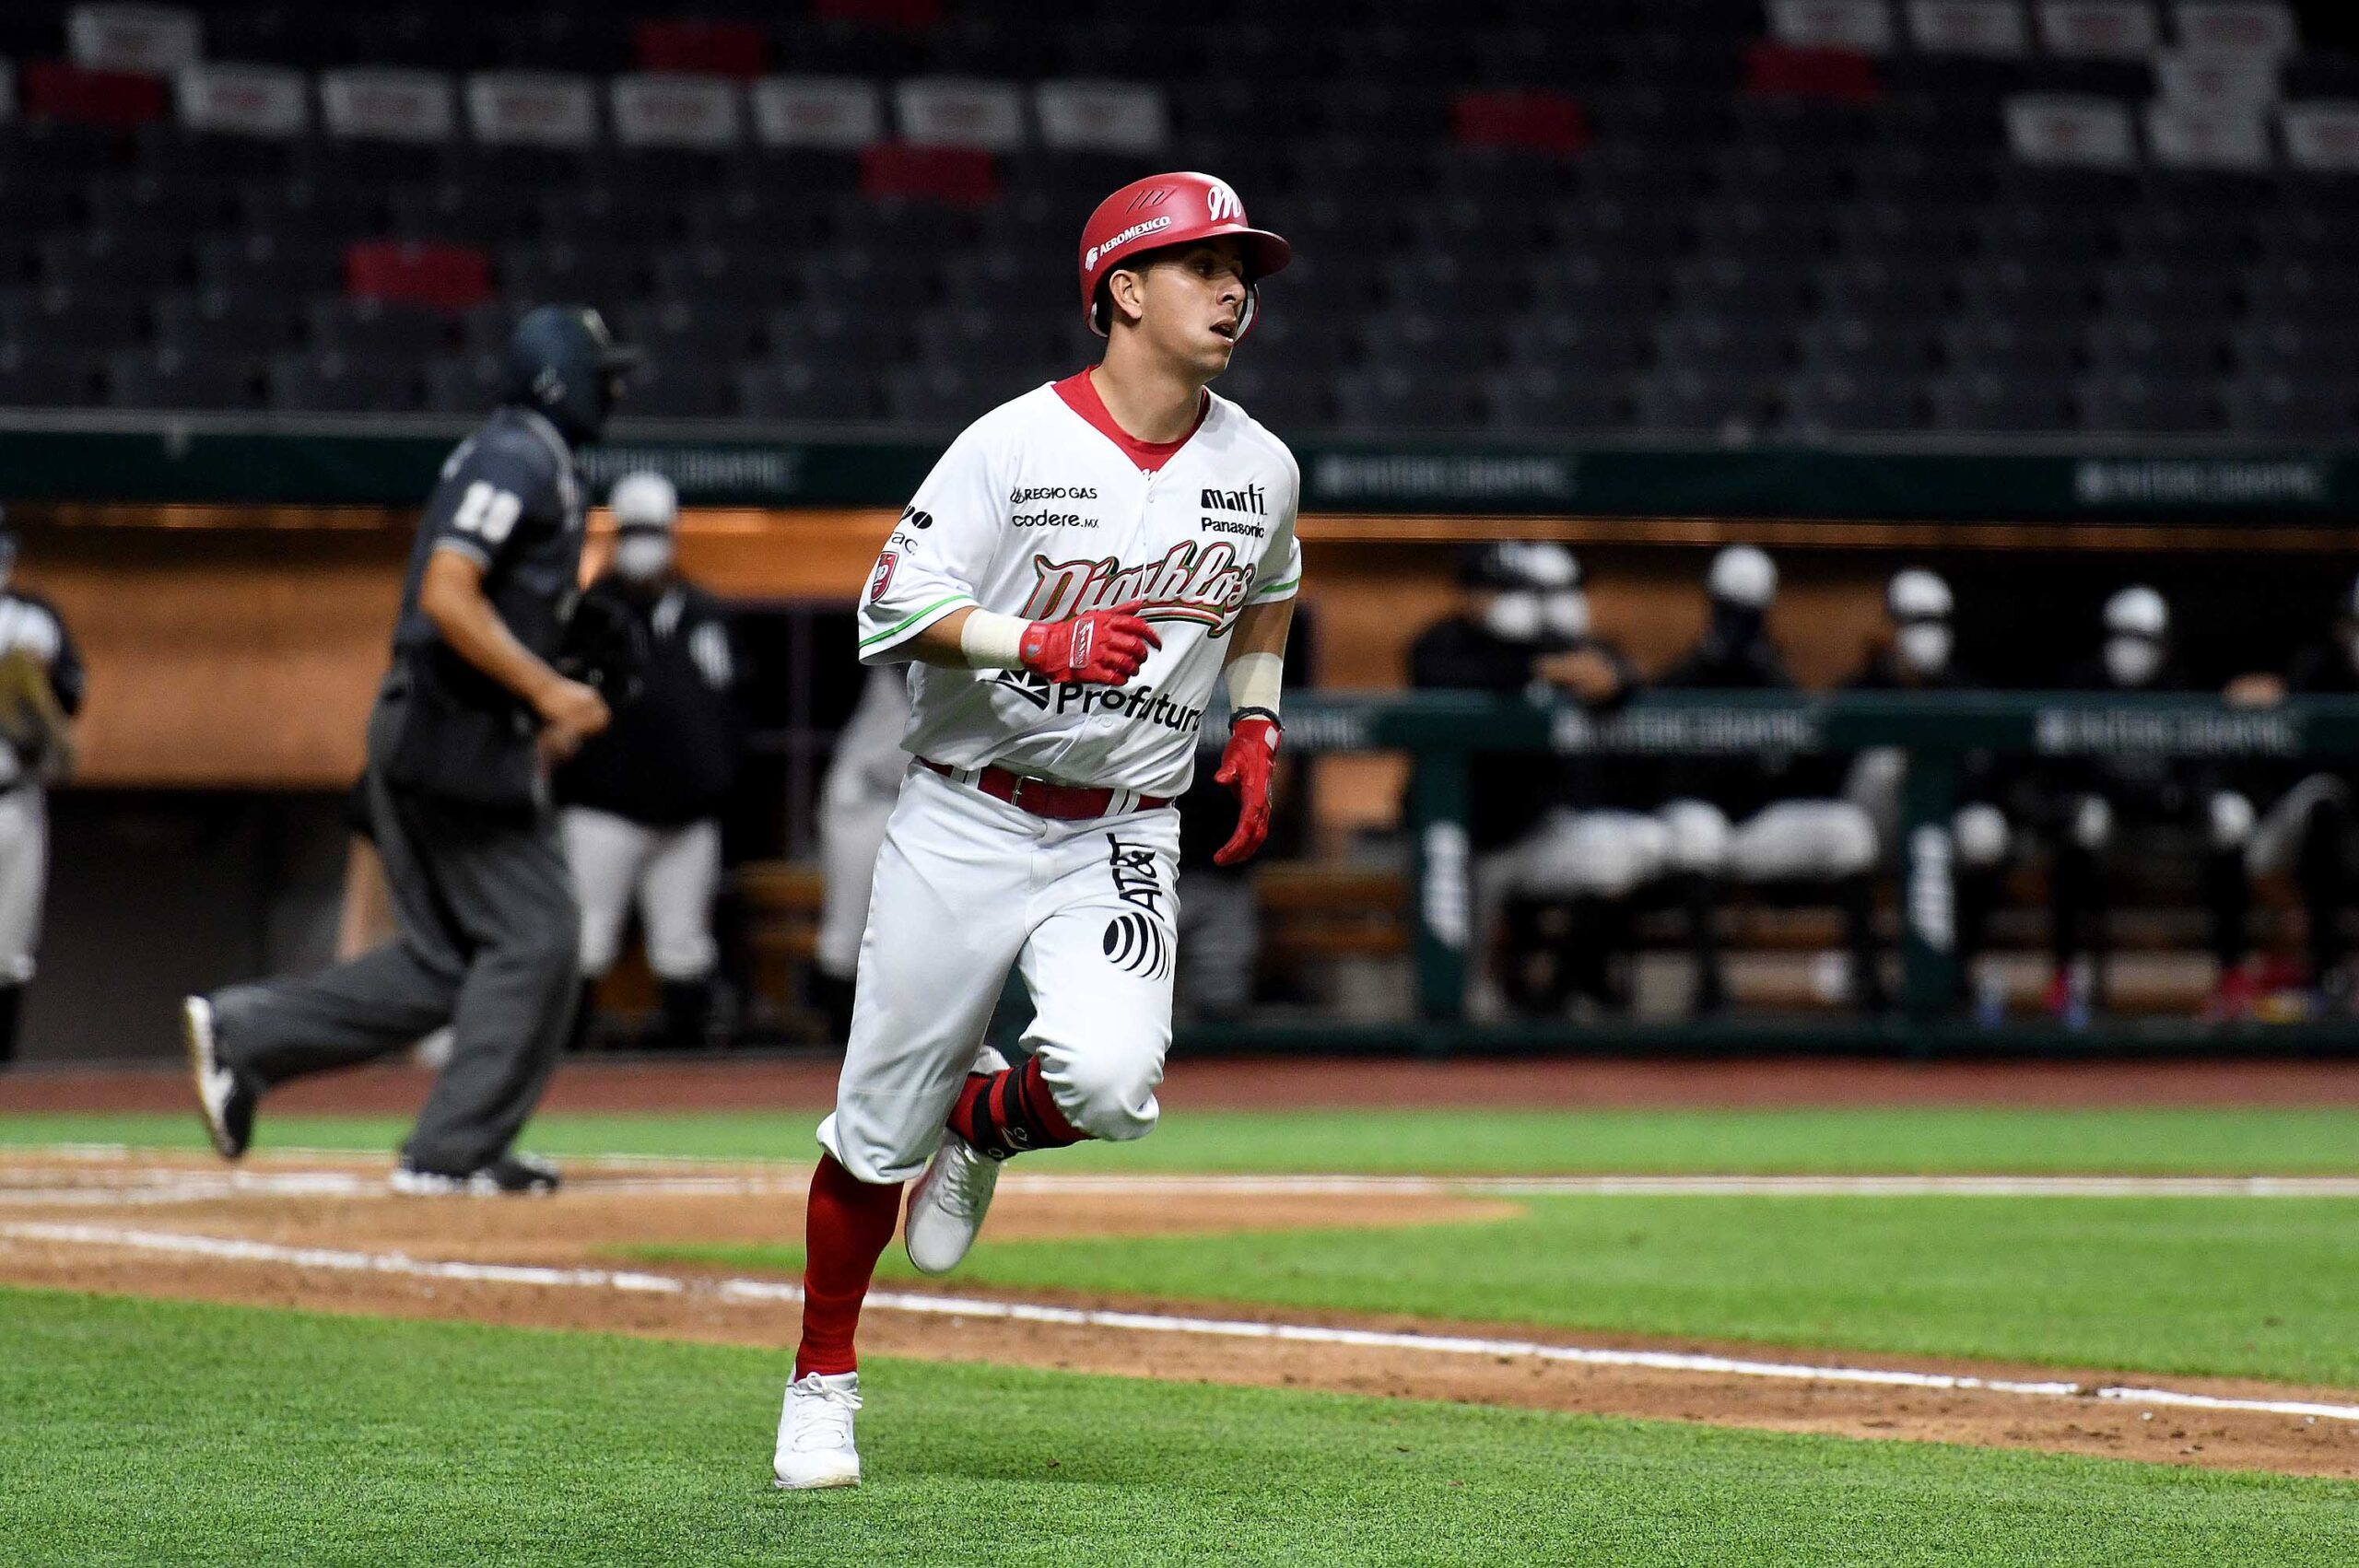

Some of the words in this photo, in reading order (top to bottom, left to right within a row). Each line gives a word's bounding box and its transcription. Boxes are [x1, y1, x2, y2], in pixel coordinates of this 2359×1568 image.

[1099, 216, 1171, 257] AEROMEXICO
[1024, 487, 1066, 500] REGIO
[1069, 487, 1097, 499] GAS
[1201, 517, 1264, 538] Panasonic
[1106, 833, 1165, 922] AT&T
